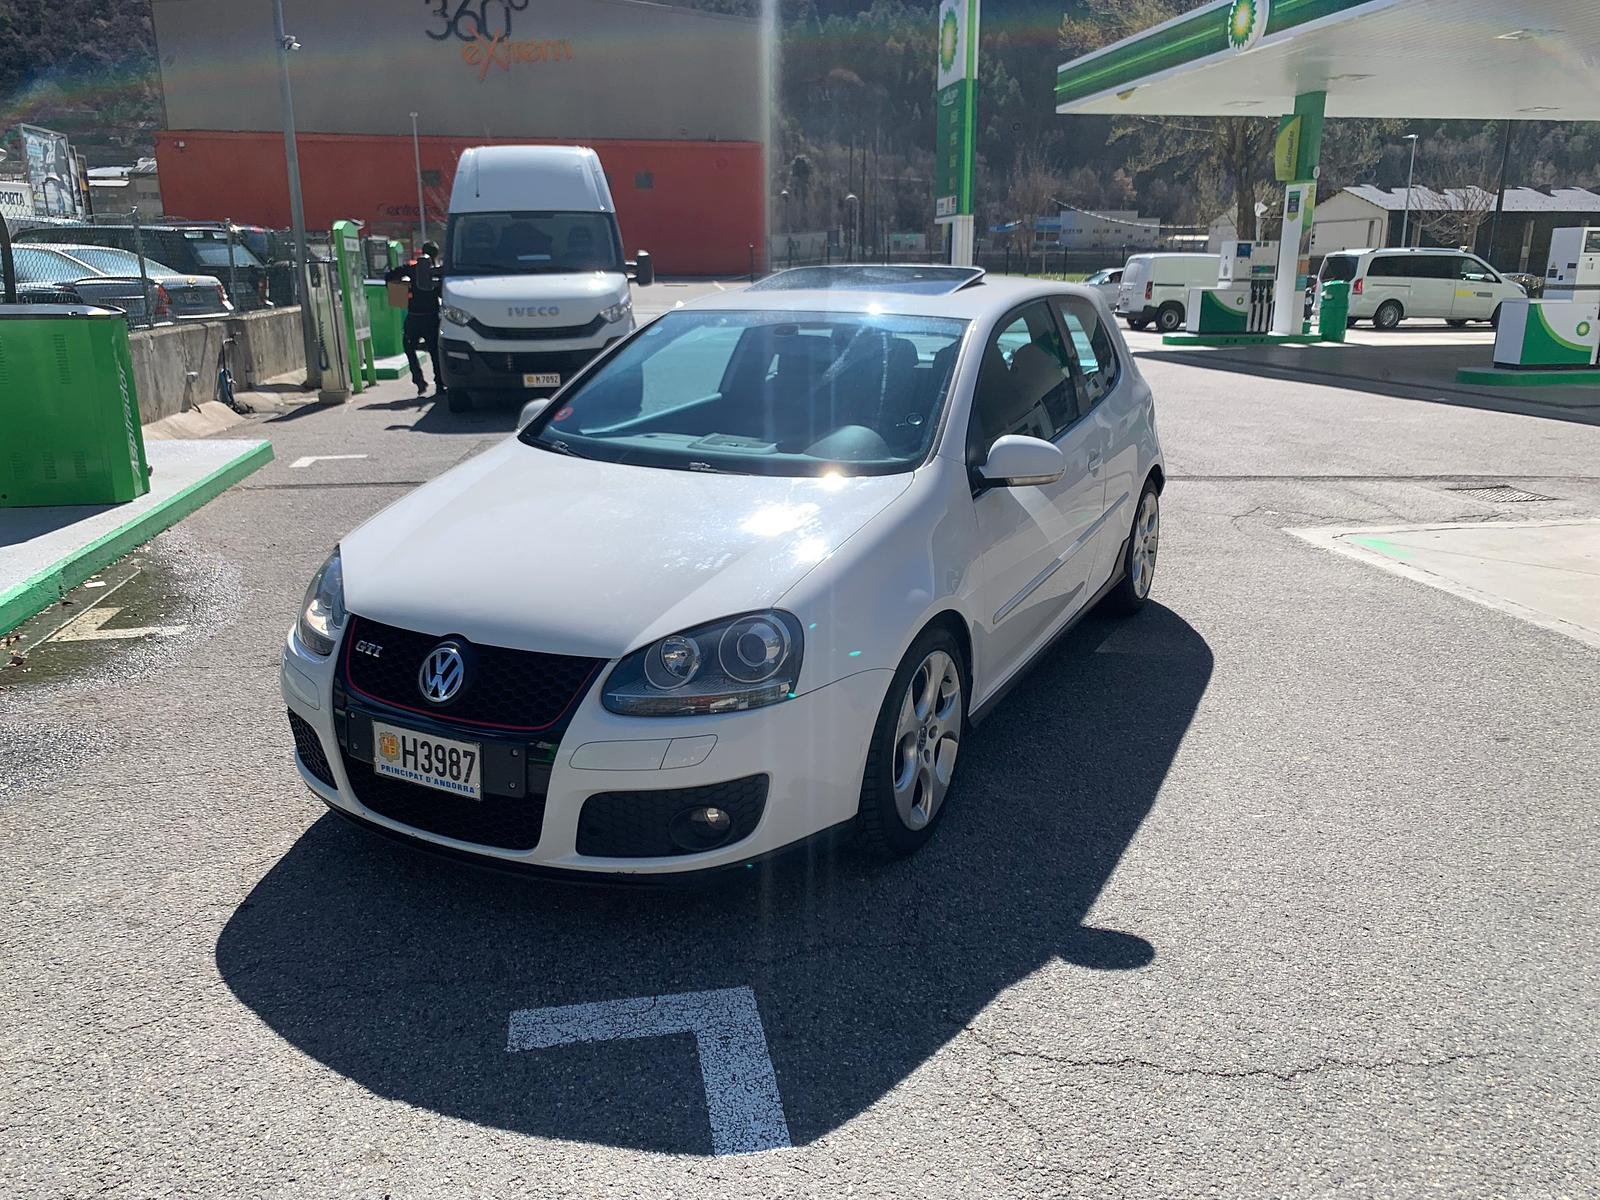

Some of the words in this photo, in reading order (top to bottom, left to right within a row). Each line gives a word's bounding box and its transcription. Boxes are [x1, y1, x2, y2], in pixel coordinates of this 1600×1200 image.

[507, 306, 559, 317] IVECO
[118, 363, 142, 478] Aspirador
[355, 640, 383, 658] GTI
[401, 735, 476, 784] H3987
[380, 763, 424, 781] PRINCIPAT
[425, 776, 476, 794] D'ANDORRA
